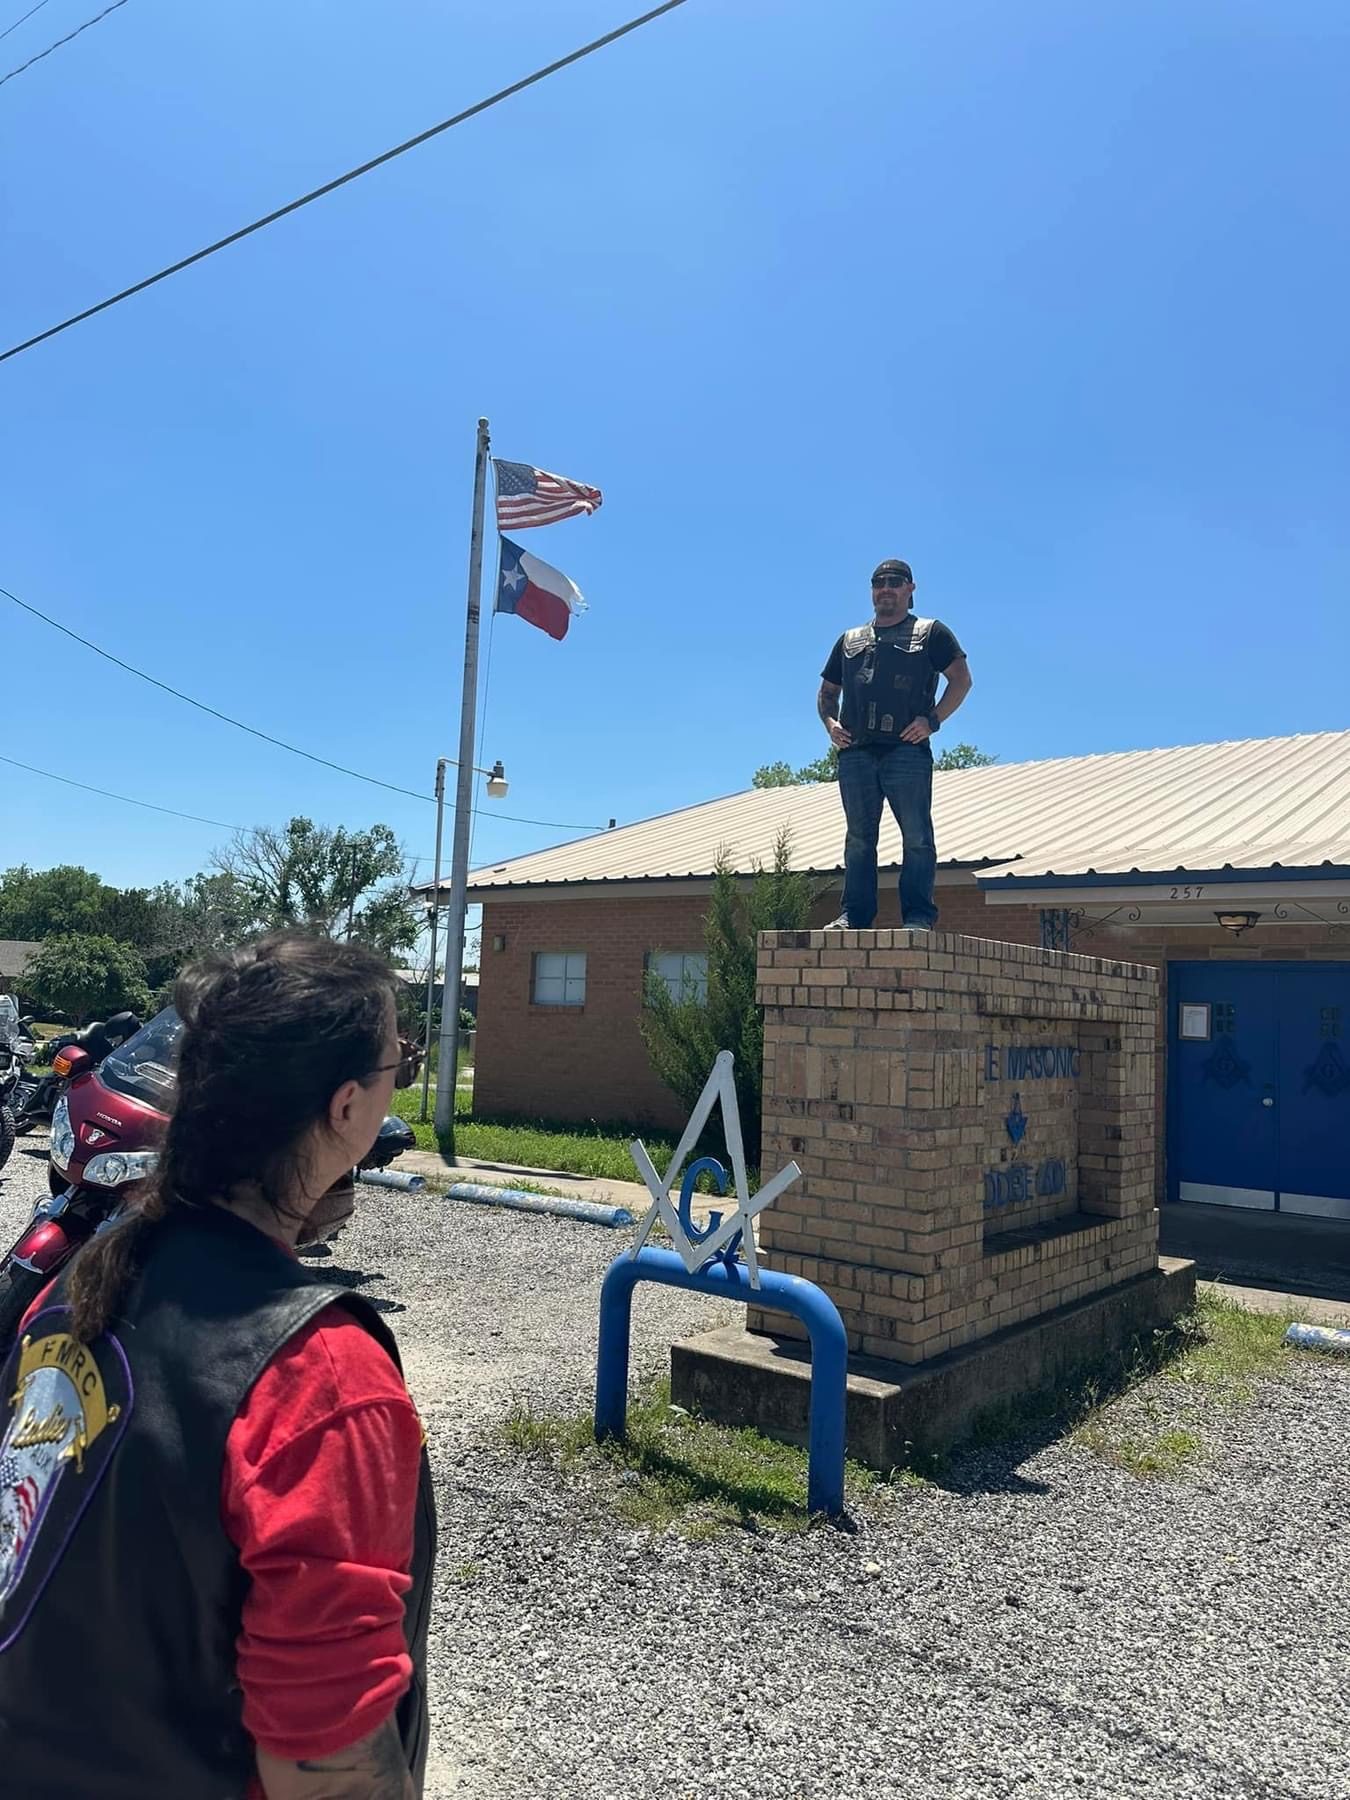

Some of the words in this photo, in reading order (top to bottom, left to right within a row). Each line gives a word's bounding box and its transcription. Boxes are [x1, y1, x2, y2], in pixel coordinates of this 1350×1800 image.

[1170, 886, 1205, 899] 257
[1007, 1045, 1081, 1080] MASONIC
[96, 1111, 122, 1127] HONDA
[678, 1156, 728, 1243] G
[41, 1340, 97, 1397] FMRC
